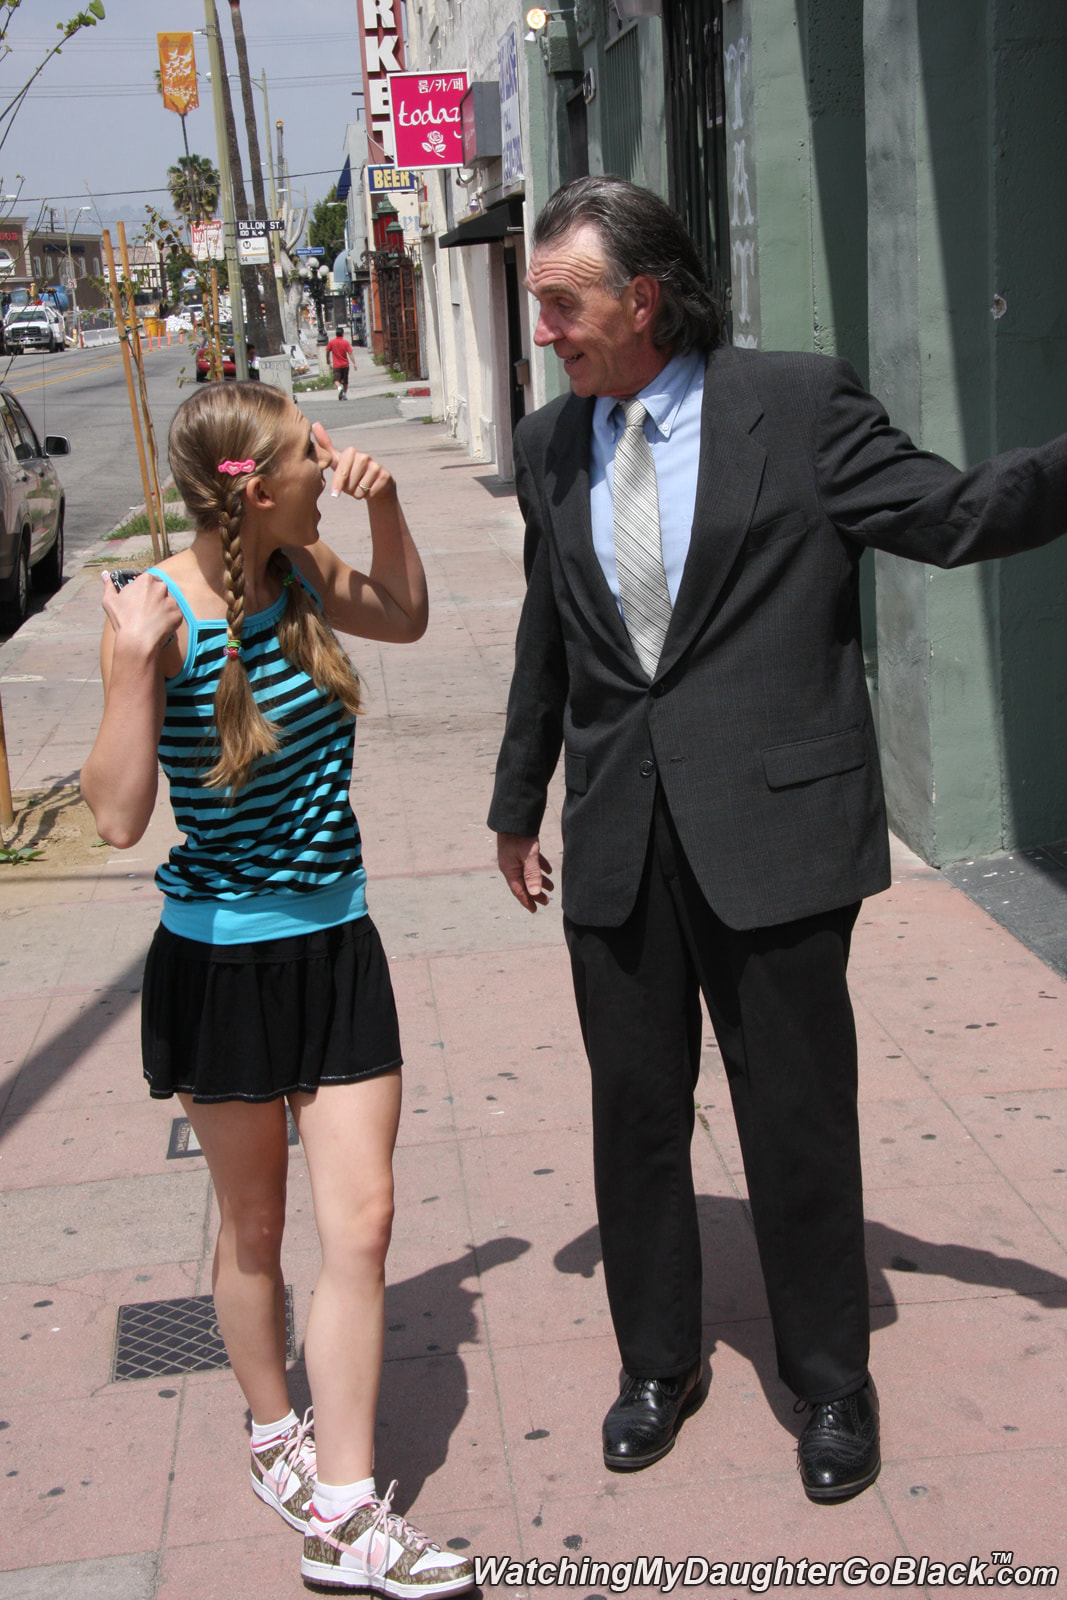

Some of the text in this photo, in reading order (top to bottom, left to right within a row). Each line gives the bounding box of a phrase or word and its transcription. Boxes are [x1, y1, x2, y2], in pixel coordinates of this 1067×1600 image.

[373, 169, 411, 189] BEER
[724, 38, 758, 350] TAT
[238, 221, 283, 230] DILLON ST.
[193, 231, 204, 242] NO
